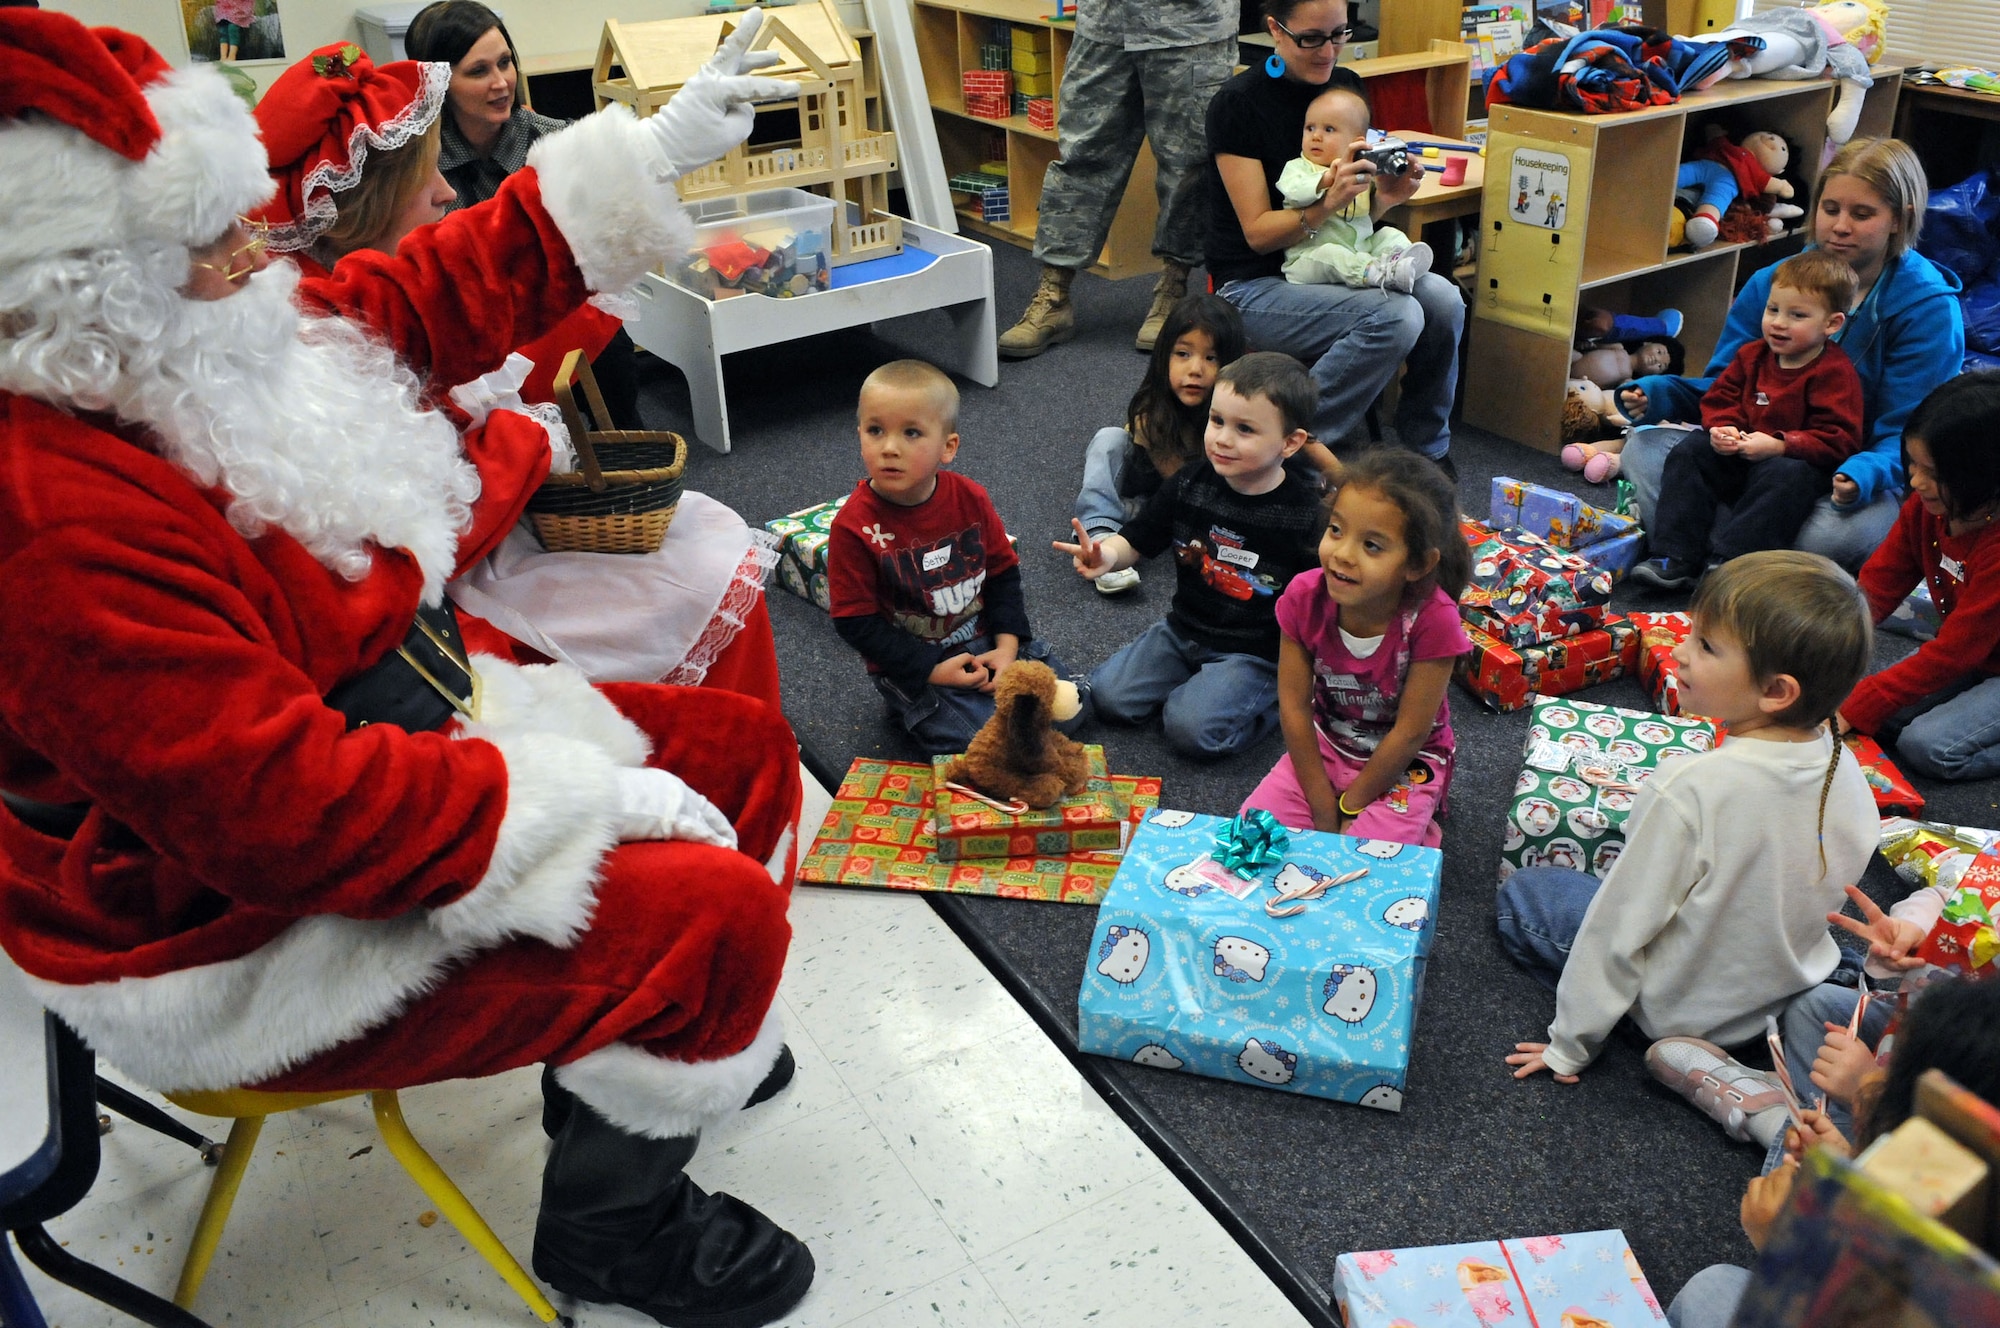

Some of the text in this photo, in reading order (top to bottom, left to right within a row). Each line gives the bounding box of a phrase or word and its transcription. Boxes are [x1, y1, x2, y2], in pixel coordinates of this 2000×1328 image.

[1515, 155, 1569, 176] Housekeeping
[1488, 233, 1498, 252] 1
[1548, 245, 1558, 264] 2
[1488, 291, 1498, 309] 3
[1543, 306, 1553, 327] 4
[924, 555, 946, 568] Seth
[1221, 548, 1254, 563] Cooper
[929, 569, 987, 617] JUST
